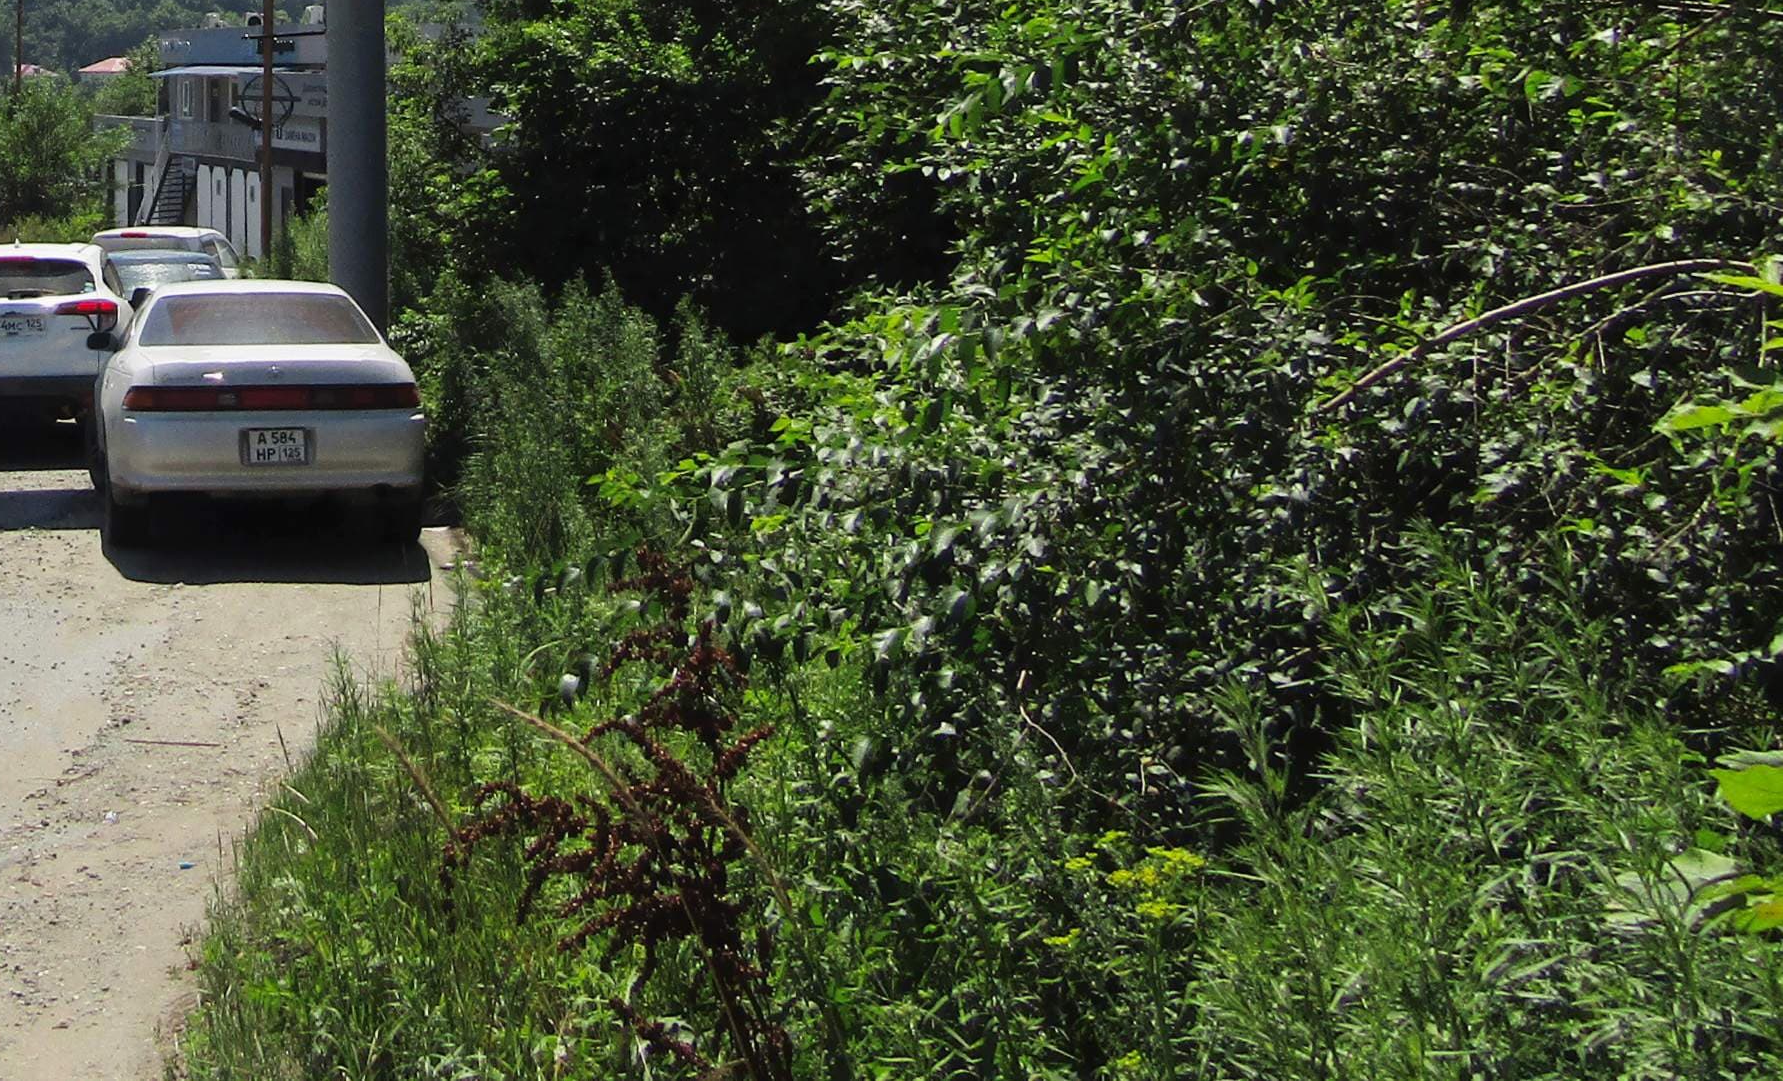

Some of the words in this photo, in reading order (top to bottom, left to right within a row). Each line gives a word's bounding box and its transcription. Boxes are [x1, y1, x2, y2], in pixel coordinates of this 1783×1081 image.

[27, 319, 42, 328] 125
[257, 432, 267, 444] А
[271, 431, 296, 444] 584
[257, 448, 276, 460] НР
[282, 448, 301, 458] 125
